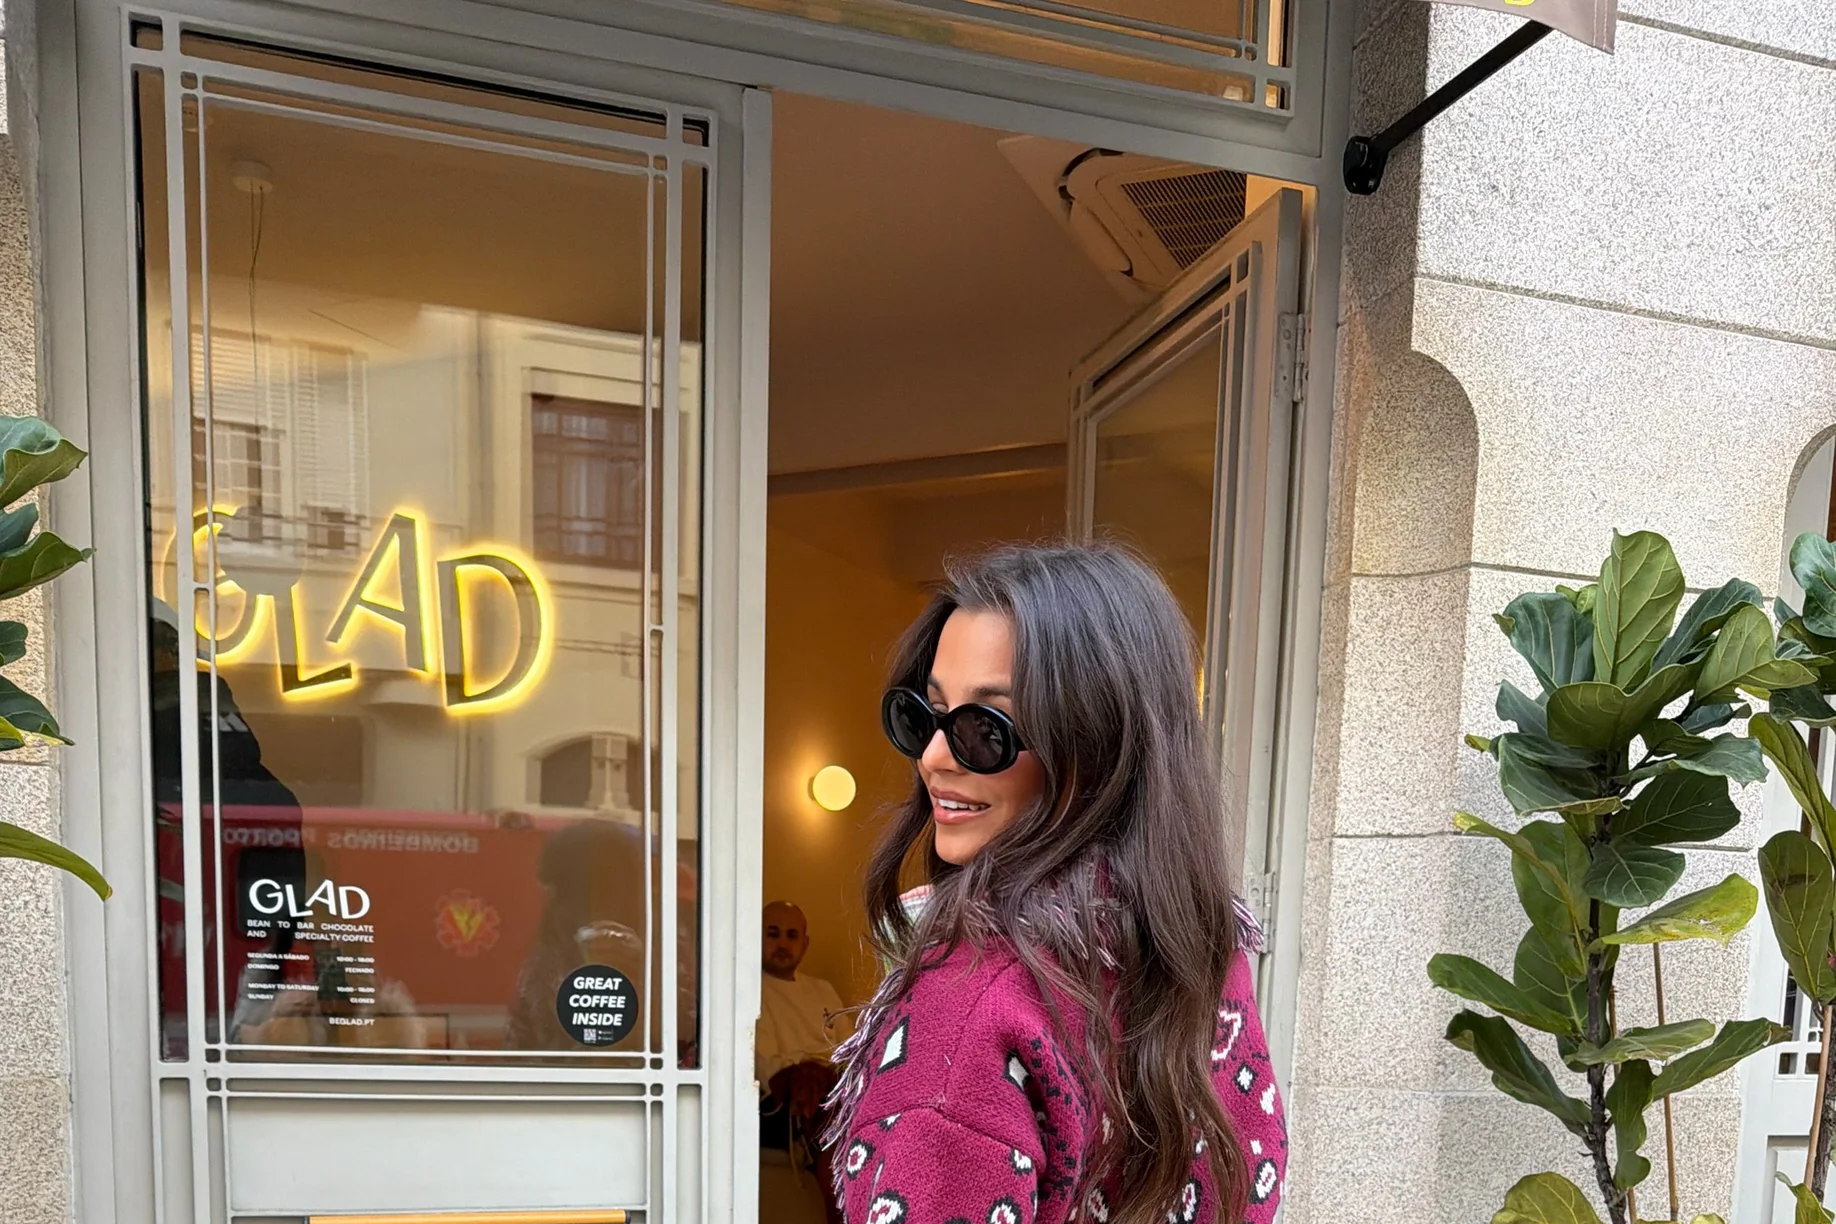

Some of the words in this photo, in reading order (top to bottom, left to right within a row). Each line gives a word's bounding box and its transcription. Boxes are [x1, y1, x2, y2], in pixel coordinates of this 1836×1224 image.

[165, 506, 547, 714] GLAD
[249, 879, 371, 920] GLAD
[247, 919, 271, 928] BEAN
[277, 920, 291, 929] TO
[297, 922, 315, 930] BAR
[320, 923, 375, 933] CHOCOLATE
[247, 930, 267, 938] AND
[294, 931, 341, 941] SPECIALTY
[341, 934, 375, 943] COFFEE
[277, 983, 286, 991] TO
[286, 984, 320, 992] SATURDAY
[573, 976, 623, 991] GREAT
[568, 994, 627, 1009] COFFEE
[572, 1012, 624, 1027] INSIDE
